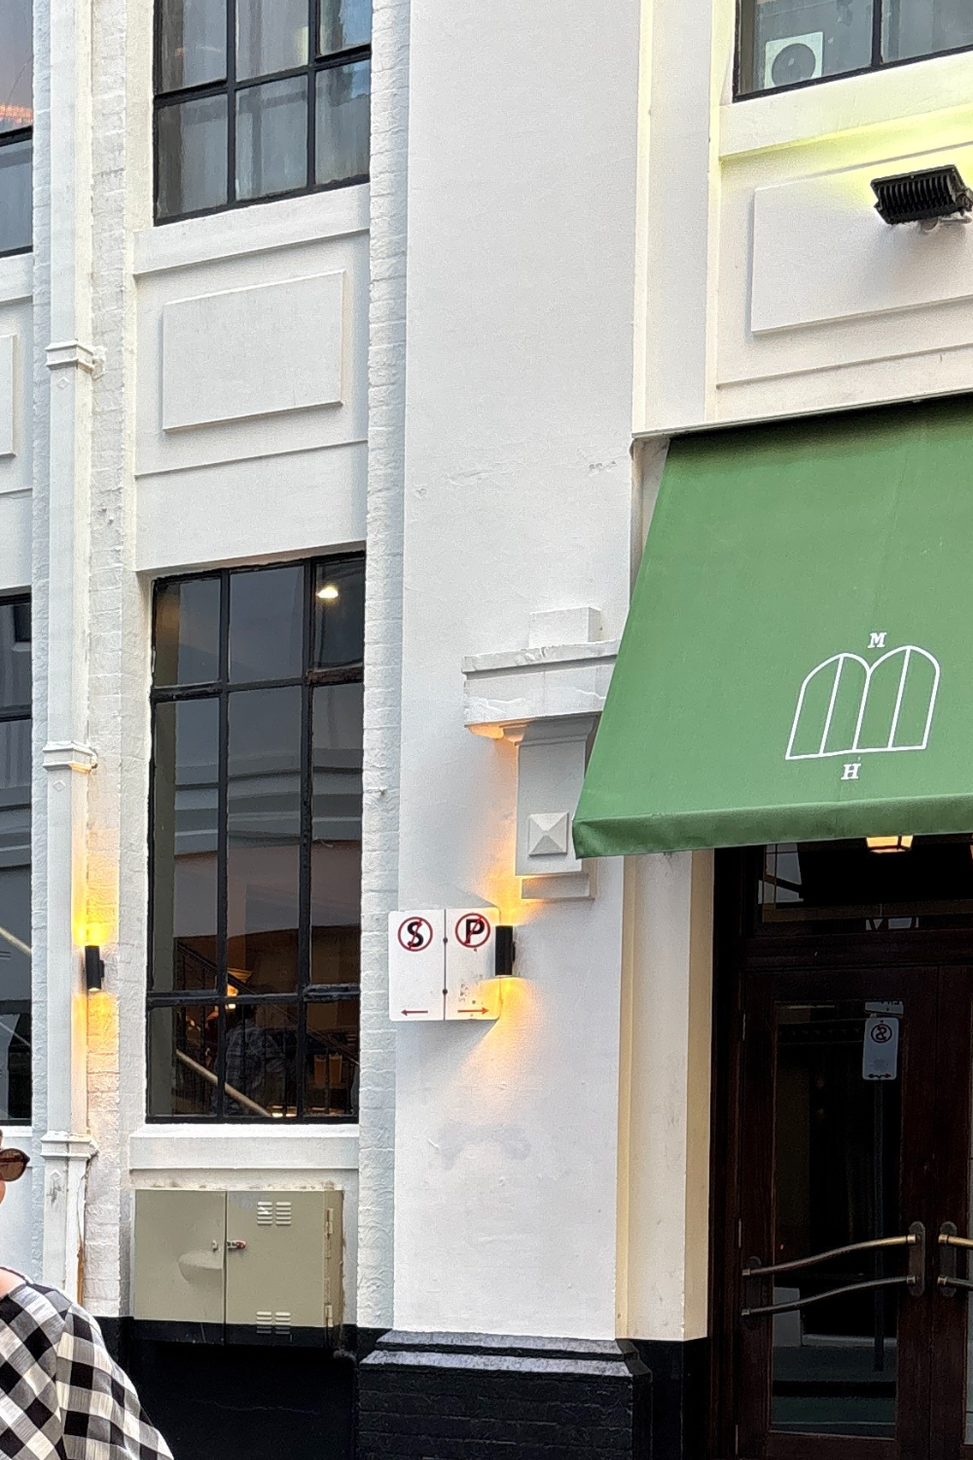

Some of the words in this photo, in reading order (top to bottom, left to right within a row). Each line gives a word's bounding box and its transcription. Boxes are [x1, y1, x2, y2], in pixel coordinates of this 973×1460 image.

[867, 632, 887, 648] M
[841, 763, 861, 780] H
[407, 921, 424, 948] S
[465, 919, 485, 944] P
